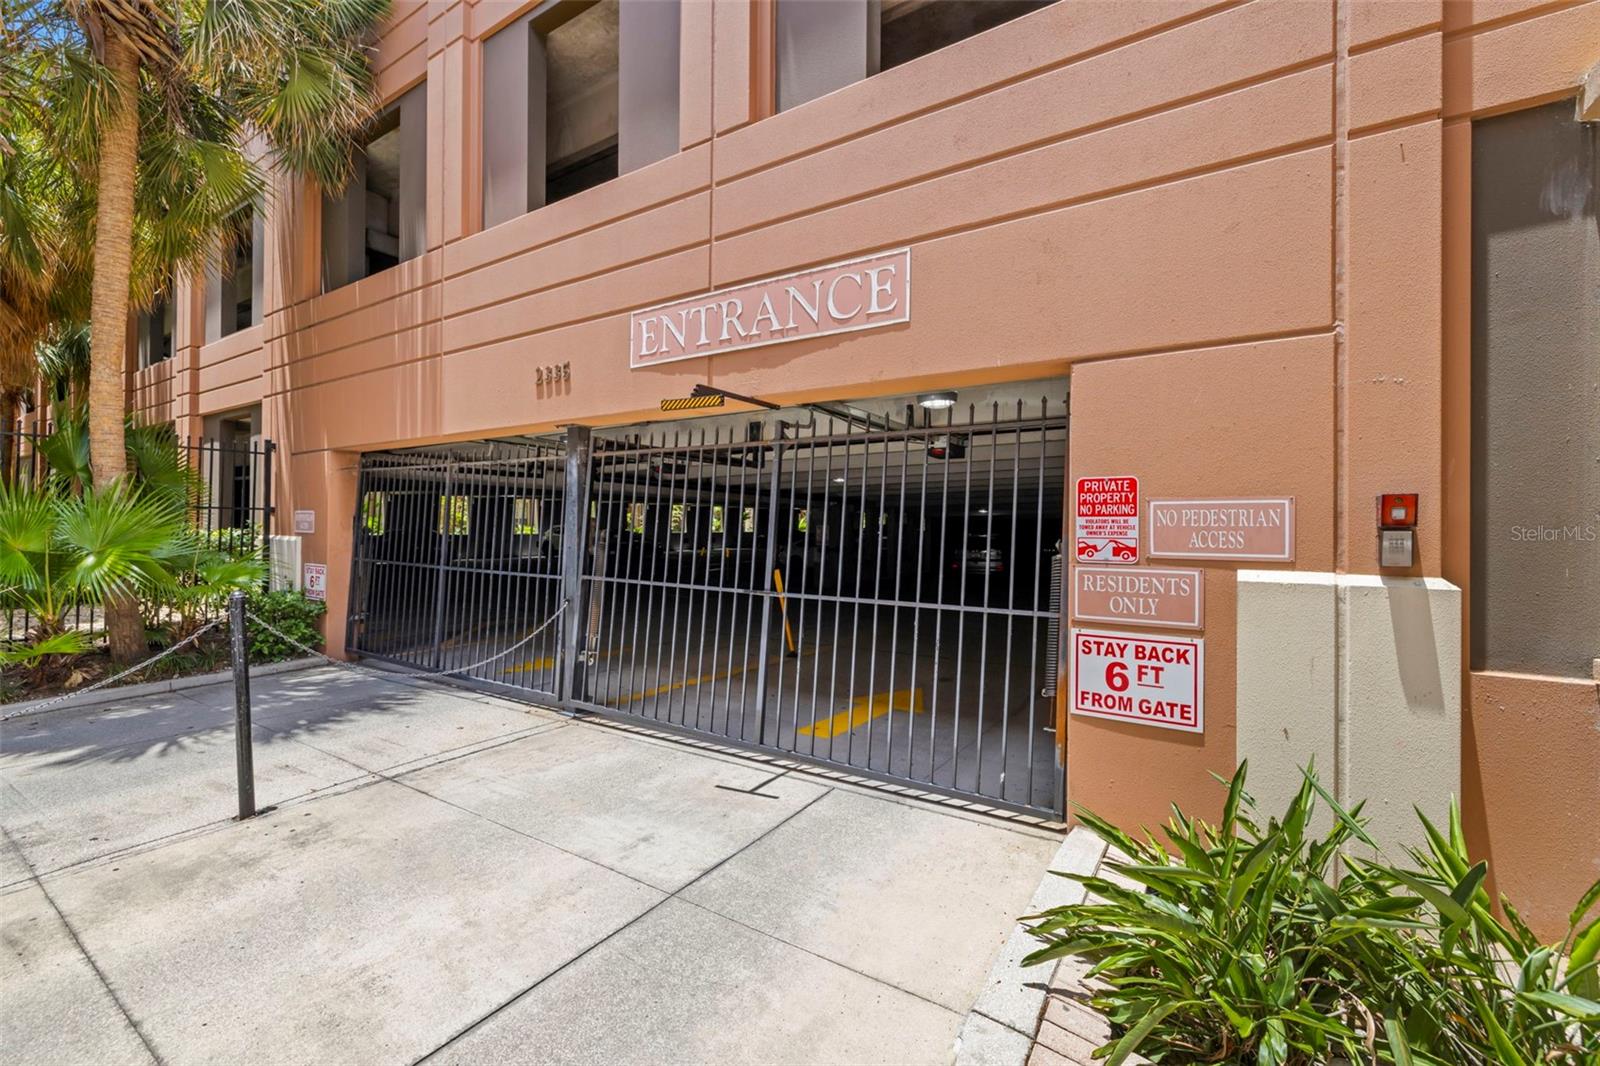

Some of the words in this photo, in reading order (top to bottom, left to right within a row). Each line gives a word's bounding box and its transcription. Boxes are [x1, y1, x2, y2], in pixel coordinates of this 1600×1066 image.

[638, 263, 899, 357] ENTRANCE
[1084, 480, 1130, 491] PRIVATE
[1079, 492, 1135, 504] PROPERTY
[1079, 504, 1093, 515] NO
[1095, 504, 1136, 515] PARKING
[1156, 510, 1178, 528] NO
[1182, 508, 1281, 527] PEDESTRIAN
[1189, 530, 1245, 549] ACCESS
[1083, 574, 1191, 596] RESIDENTS
[1109, 596, 1159, 616] ONLY
[1081, 640, 1129, 658] STAY
[1134, 644, 1191, 665] BACK
[1105, 661, 1130, 692] 6
[1137, 664, 1165, 685] FT
[1080, 691, 1133, 713] FROM
[1138, 698, 1192, 721] GATE
